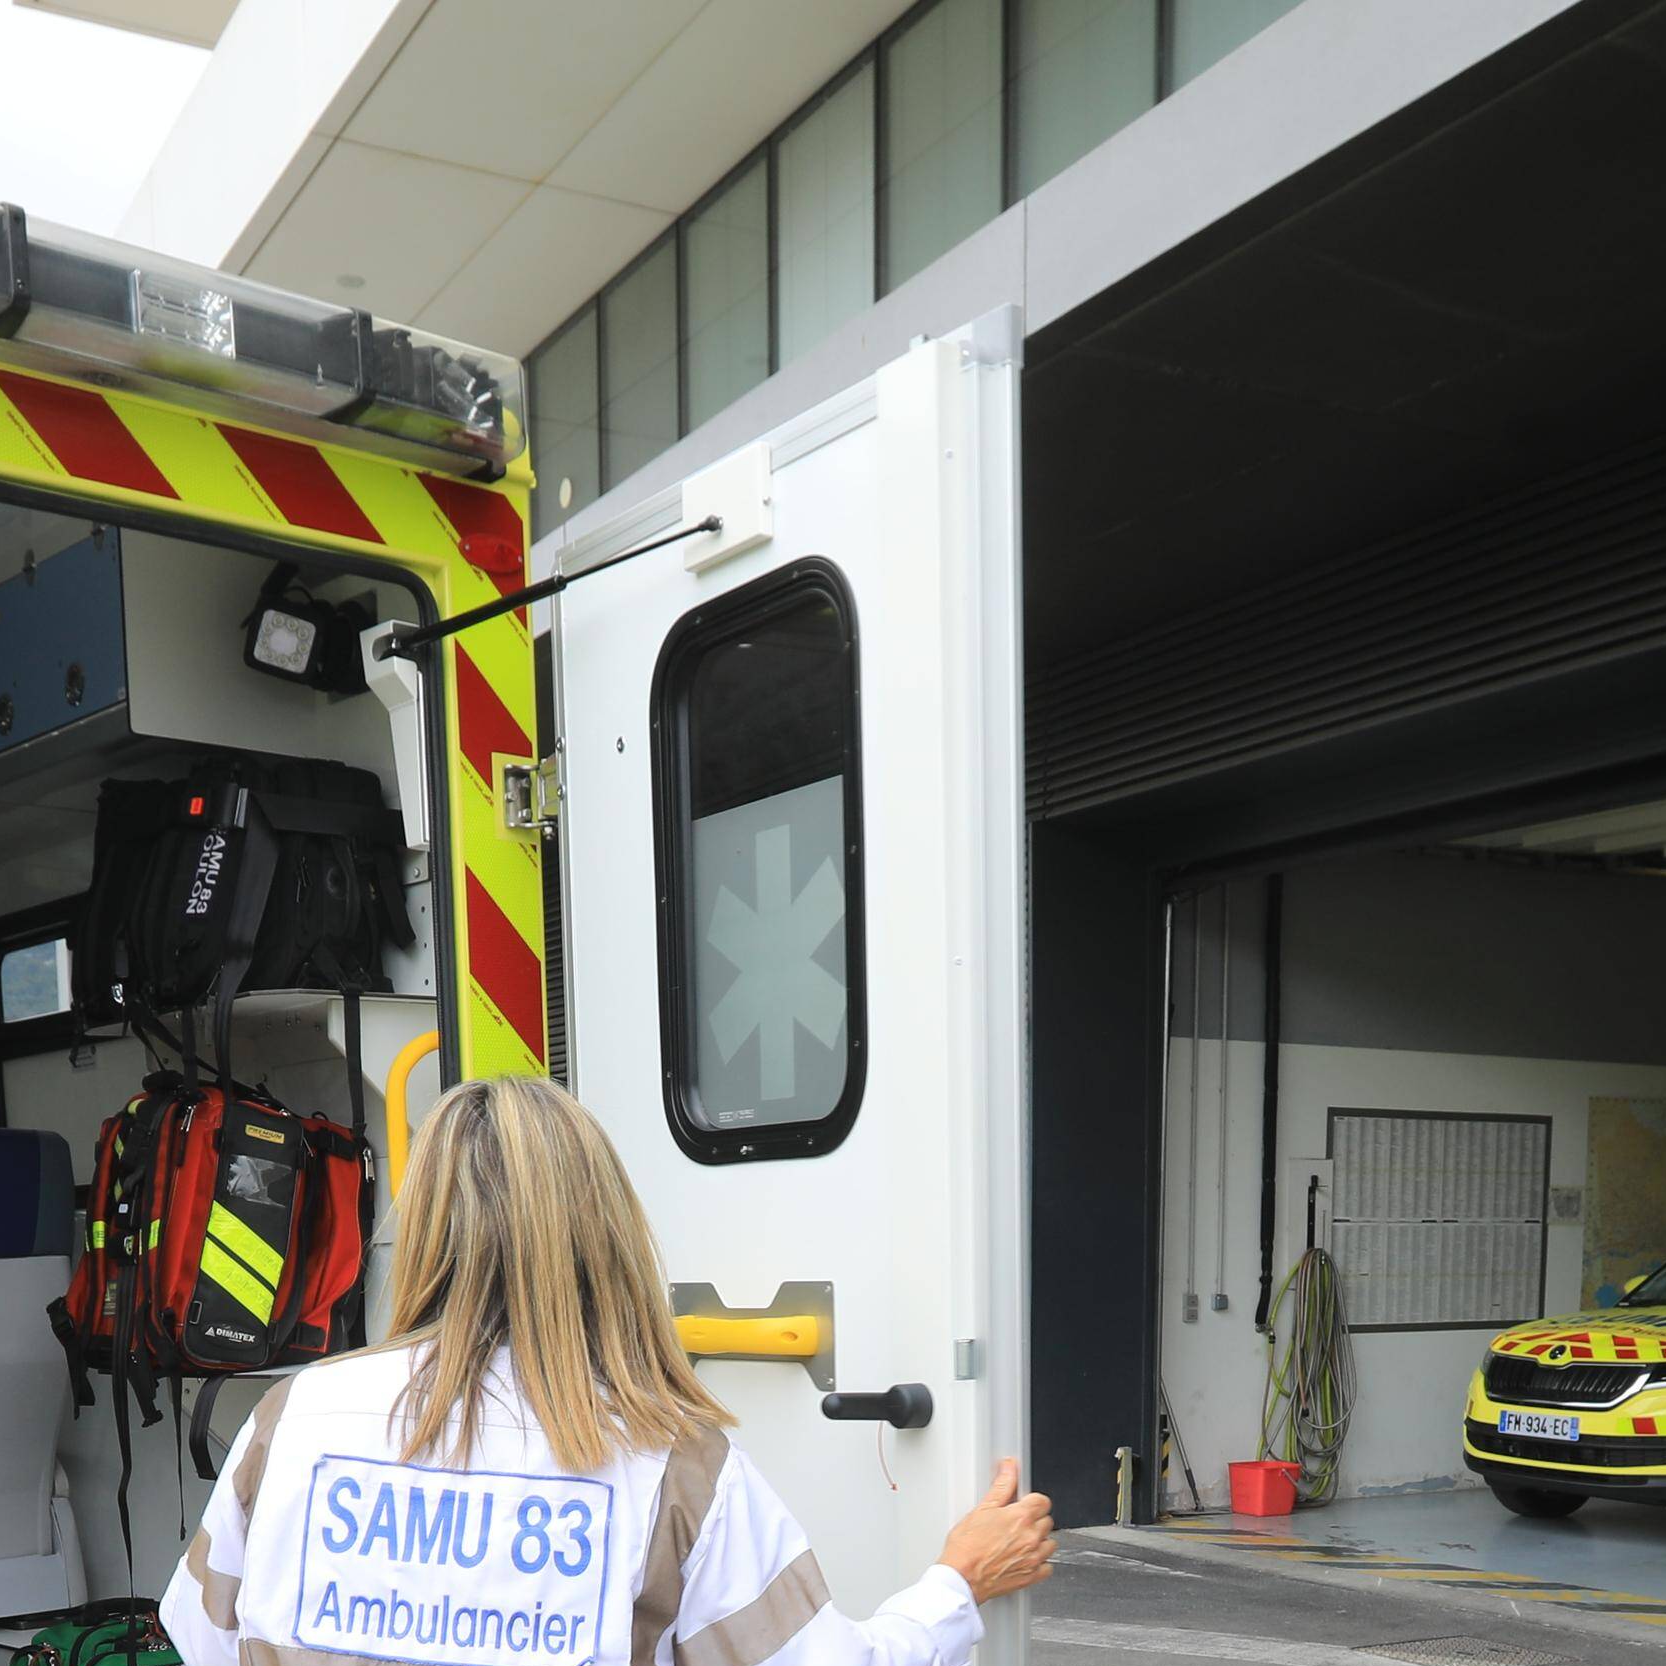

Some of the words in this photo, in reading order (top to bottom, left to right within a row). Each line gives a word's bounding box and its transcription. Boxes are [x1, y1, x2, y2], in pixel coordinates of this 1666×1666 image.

[186, 834, 214, 914] OULON
[205, 832, 226, 885] AMU
[196, 888, 212, 914] 83
[215, 1327, 256, 1343] DIMATEX
[321, 1476, 493, 1569] SAMU
[511, 1495, 593, 1577] 83
[313, 1581, 585, 1655] Ambulancier
